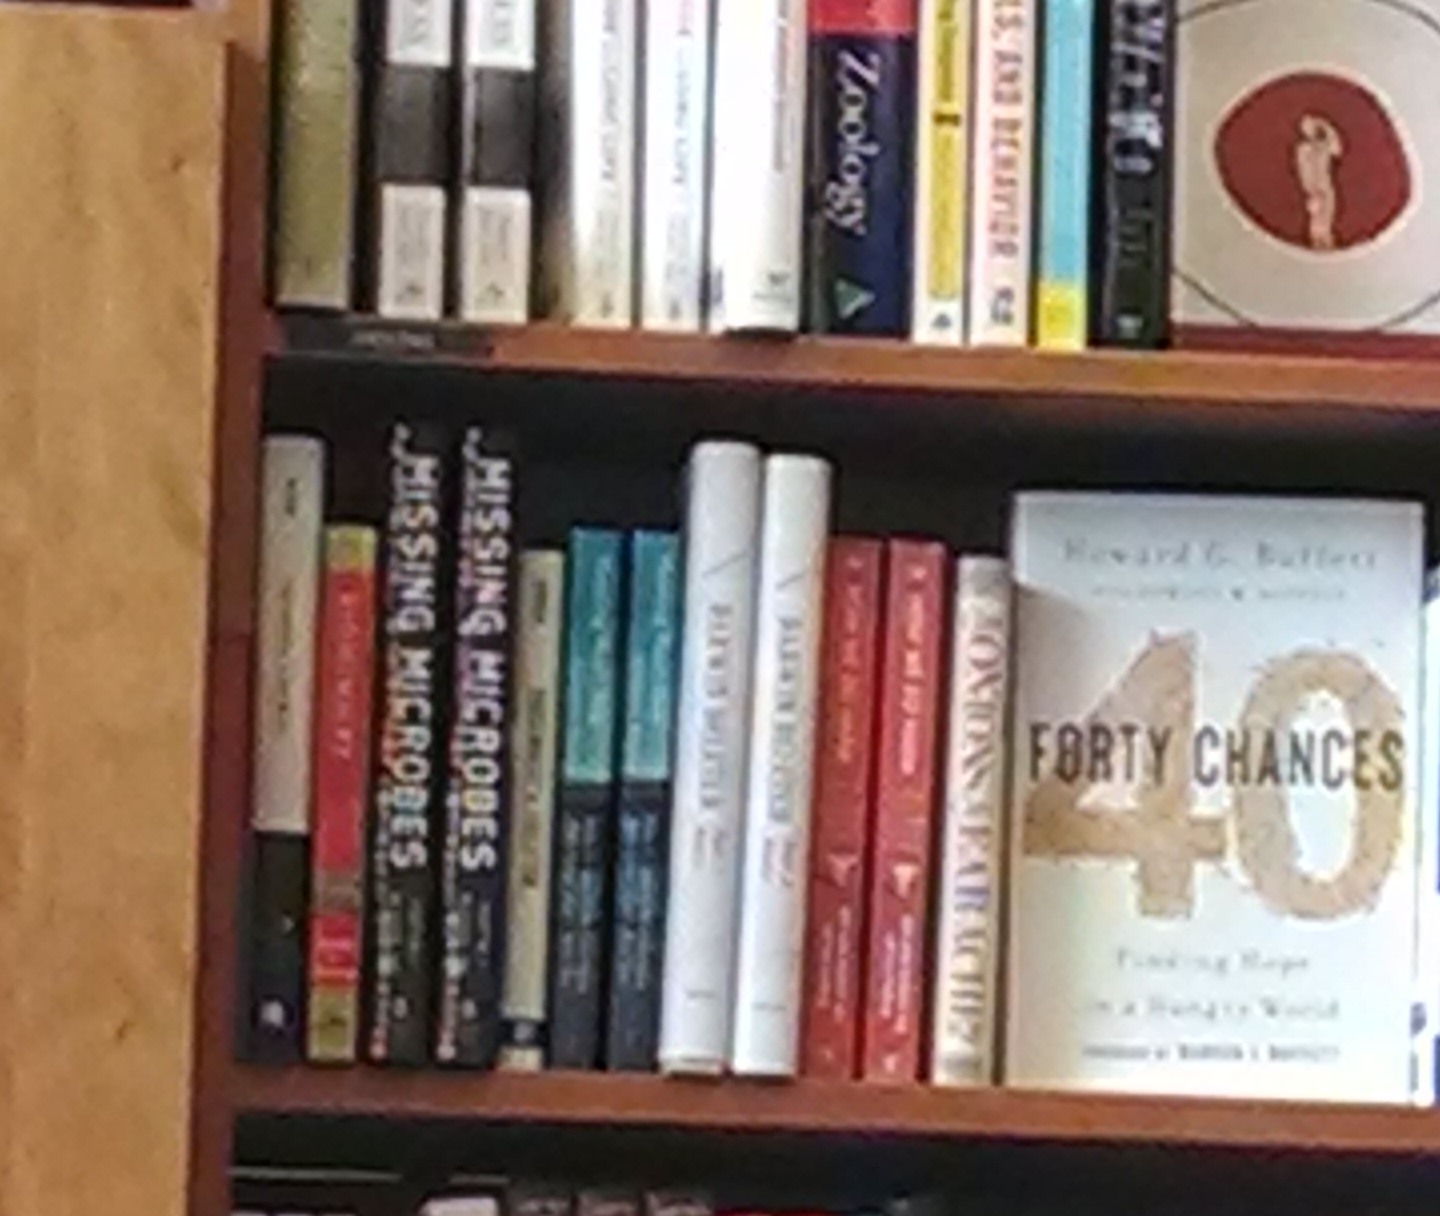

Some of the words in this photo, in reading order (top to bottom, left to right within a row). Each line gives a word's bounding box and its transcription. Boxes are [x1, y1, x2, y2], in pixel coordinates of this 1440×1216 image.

[827, 50, 881, 236] Zoology
[389, 455, 439, 633] MISSING
[460, 458, 512, 635] MISSING
[388, 647, 433, 869] MICROBES
[460, 649, 502, 871] MICROBES
[1029, 722, 1172, 785] FORTY
[1192, 727, 1406, 803] CHANCES
